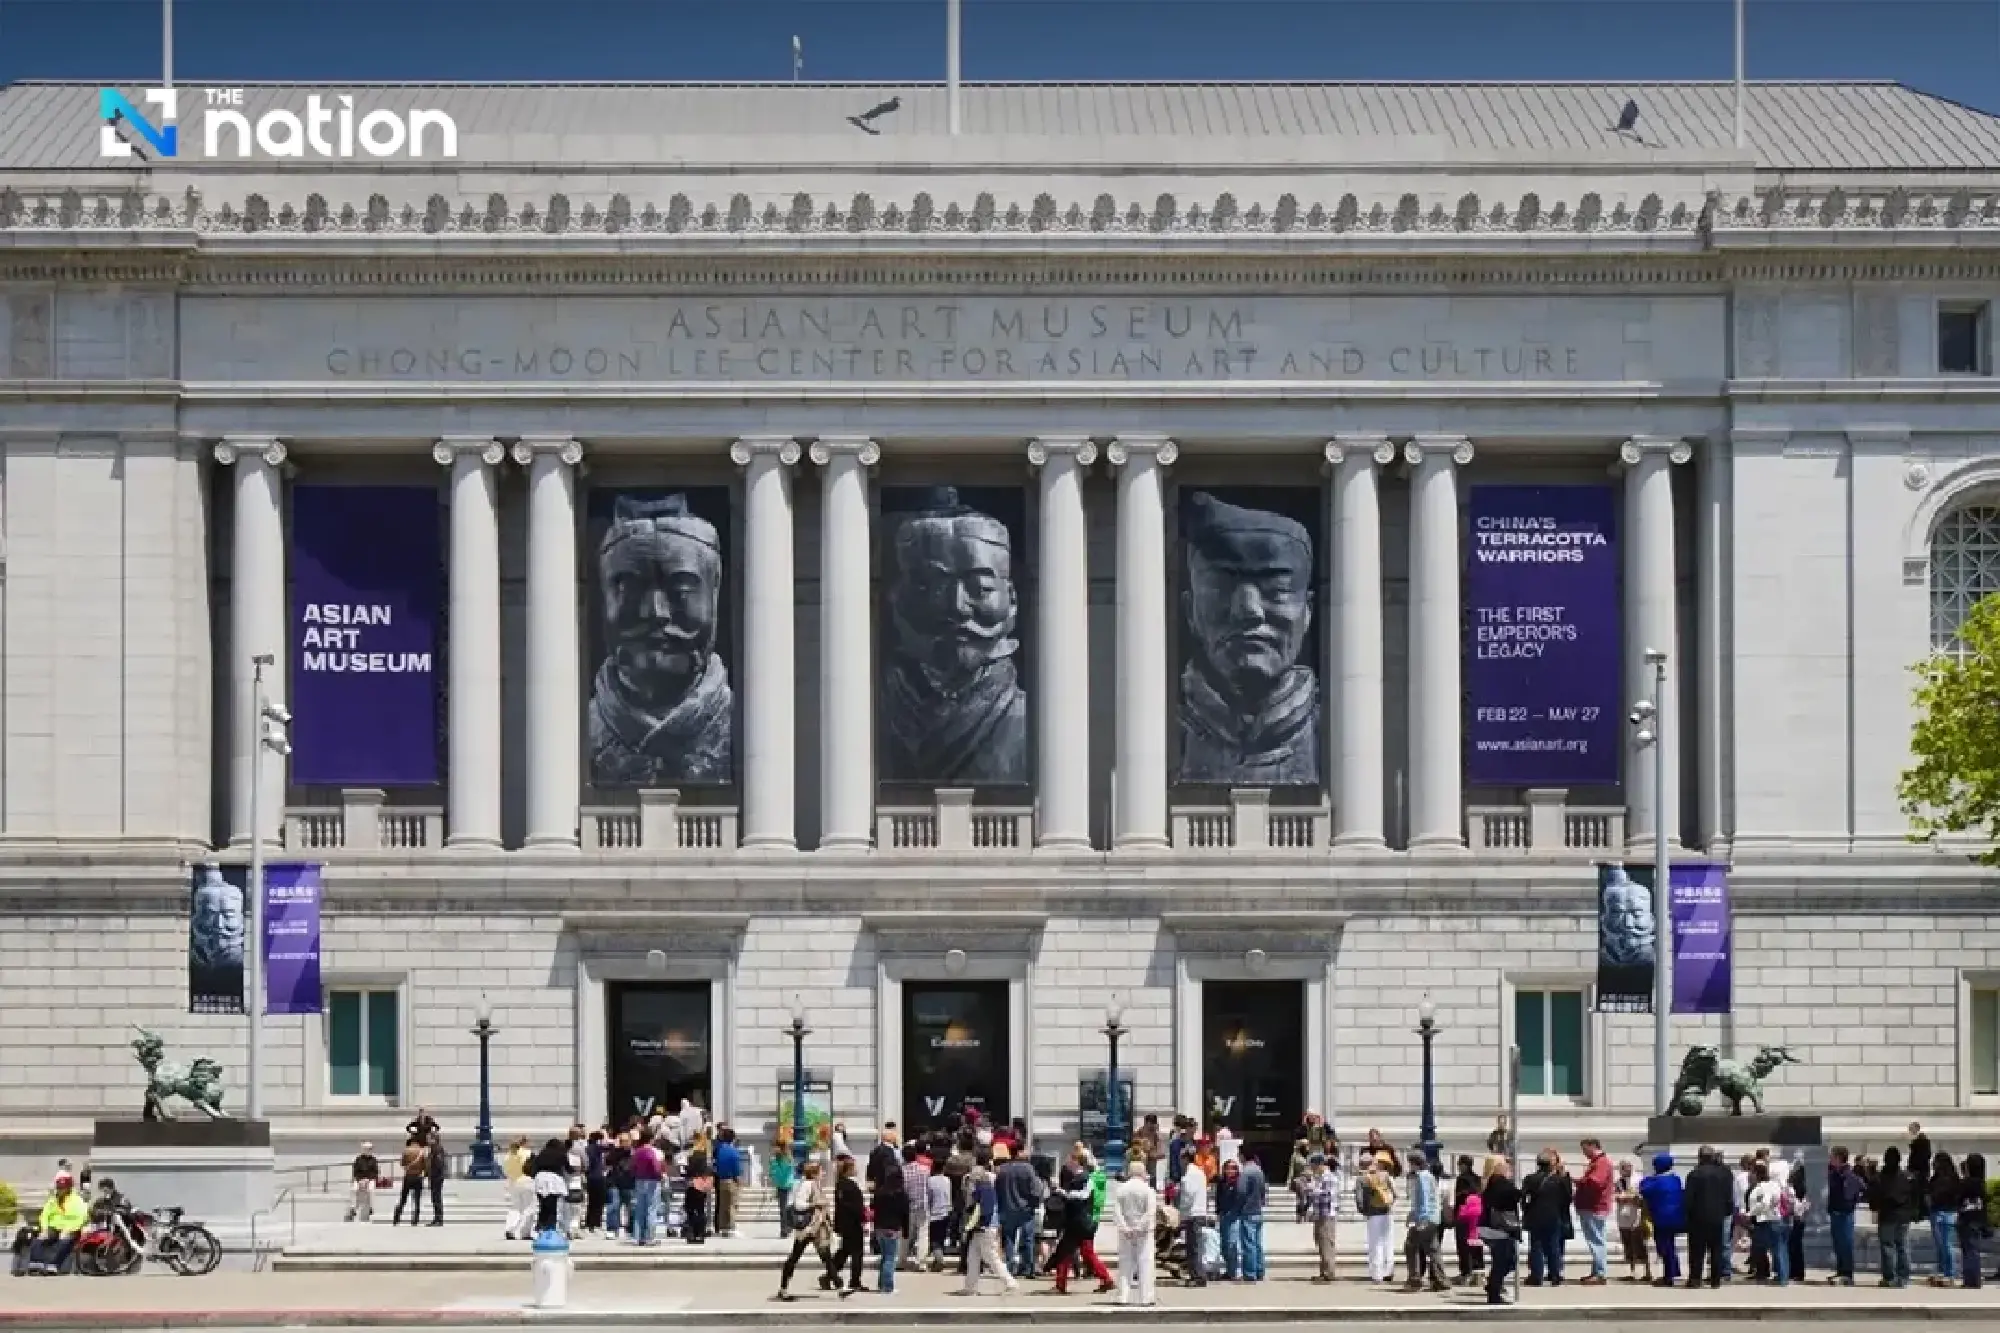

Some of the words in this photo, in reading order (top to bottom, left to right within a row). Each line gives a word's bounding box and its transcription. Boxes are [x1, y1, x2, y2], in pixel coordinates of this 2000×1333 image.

[668, 306, 830, 339] ASIAN
[859, 306, 961, 339] ART
[991, 306, 1242, 339] MUSEUM
[326, 347, 641, 375] CHONG-MOON
[668, 348, 731, 375] LEE
[757, 348, 917, 375] CENTER
[941, 348, 1017, 375] FOR
[1041, 348, 1163, 375] ASIAN
[1185, 348, 1258, 375] ART
[1280, 348, 1364, 375] AND
[1390, 347, 1578, 375] CULTURE
[1477, 516, 1557, 529] CHINA'S
[1476, 532, 1607, 545] TERRACOTTA
[1476, 549, 1584, 562] WARRIORS
[302, 604, 392, 625] ASIAN
[1477, 606, 1510, 622] THE
[1516, 606, 1565, 622] FIRST
[302, 626, 360, 649] ART
[1477, 624, 1577, 641] EMPEROR'S
[1477, 642, 1545, 658] LEGACY
[303, 651, 432, 672] MUSEUM
[1477, 706, 1507, 721] FEB
[1508, 706, 1527, 721] 22
[1549, 706, 1576, 721] MAY
[1581, 706, 1600, 721] 27
[1477, 738, 1588, 754] www.asianart.org
